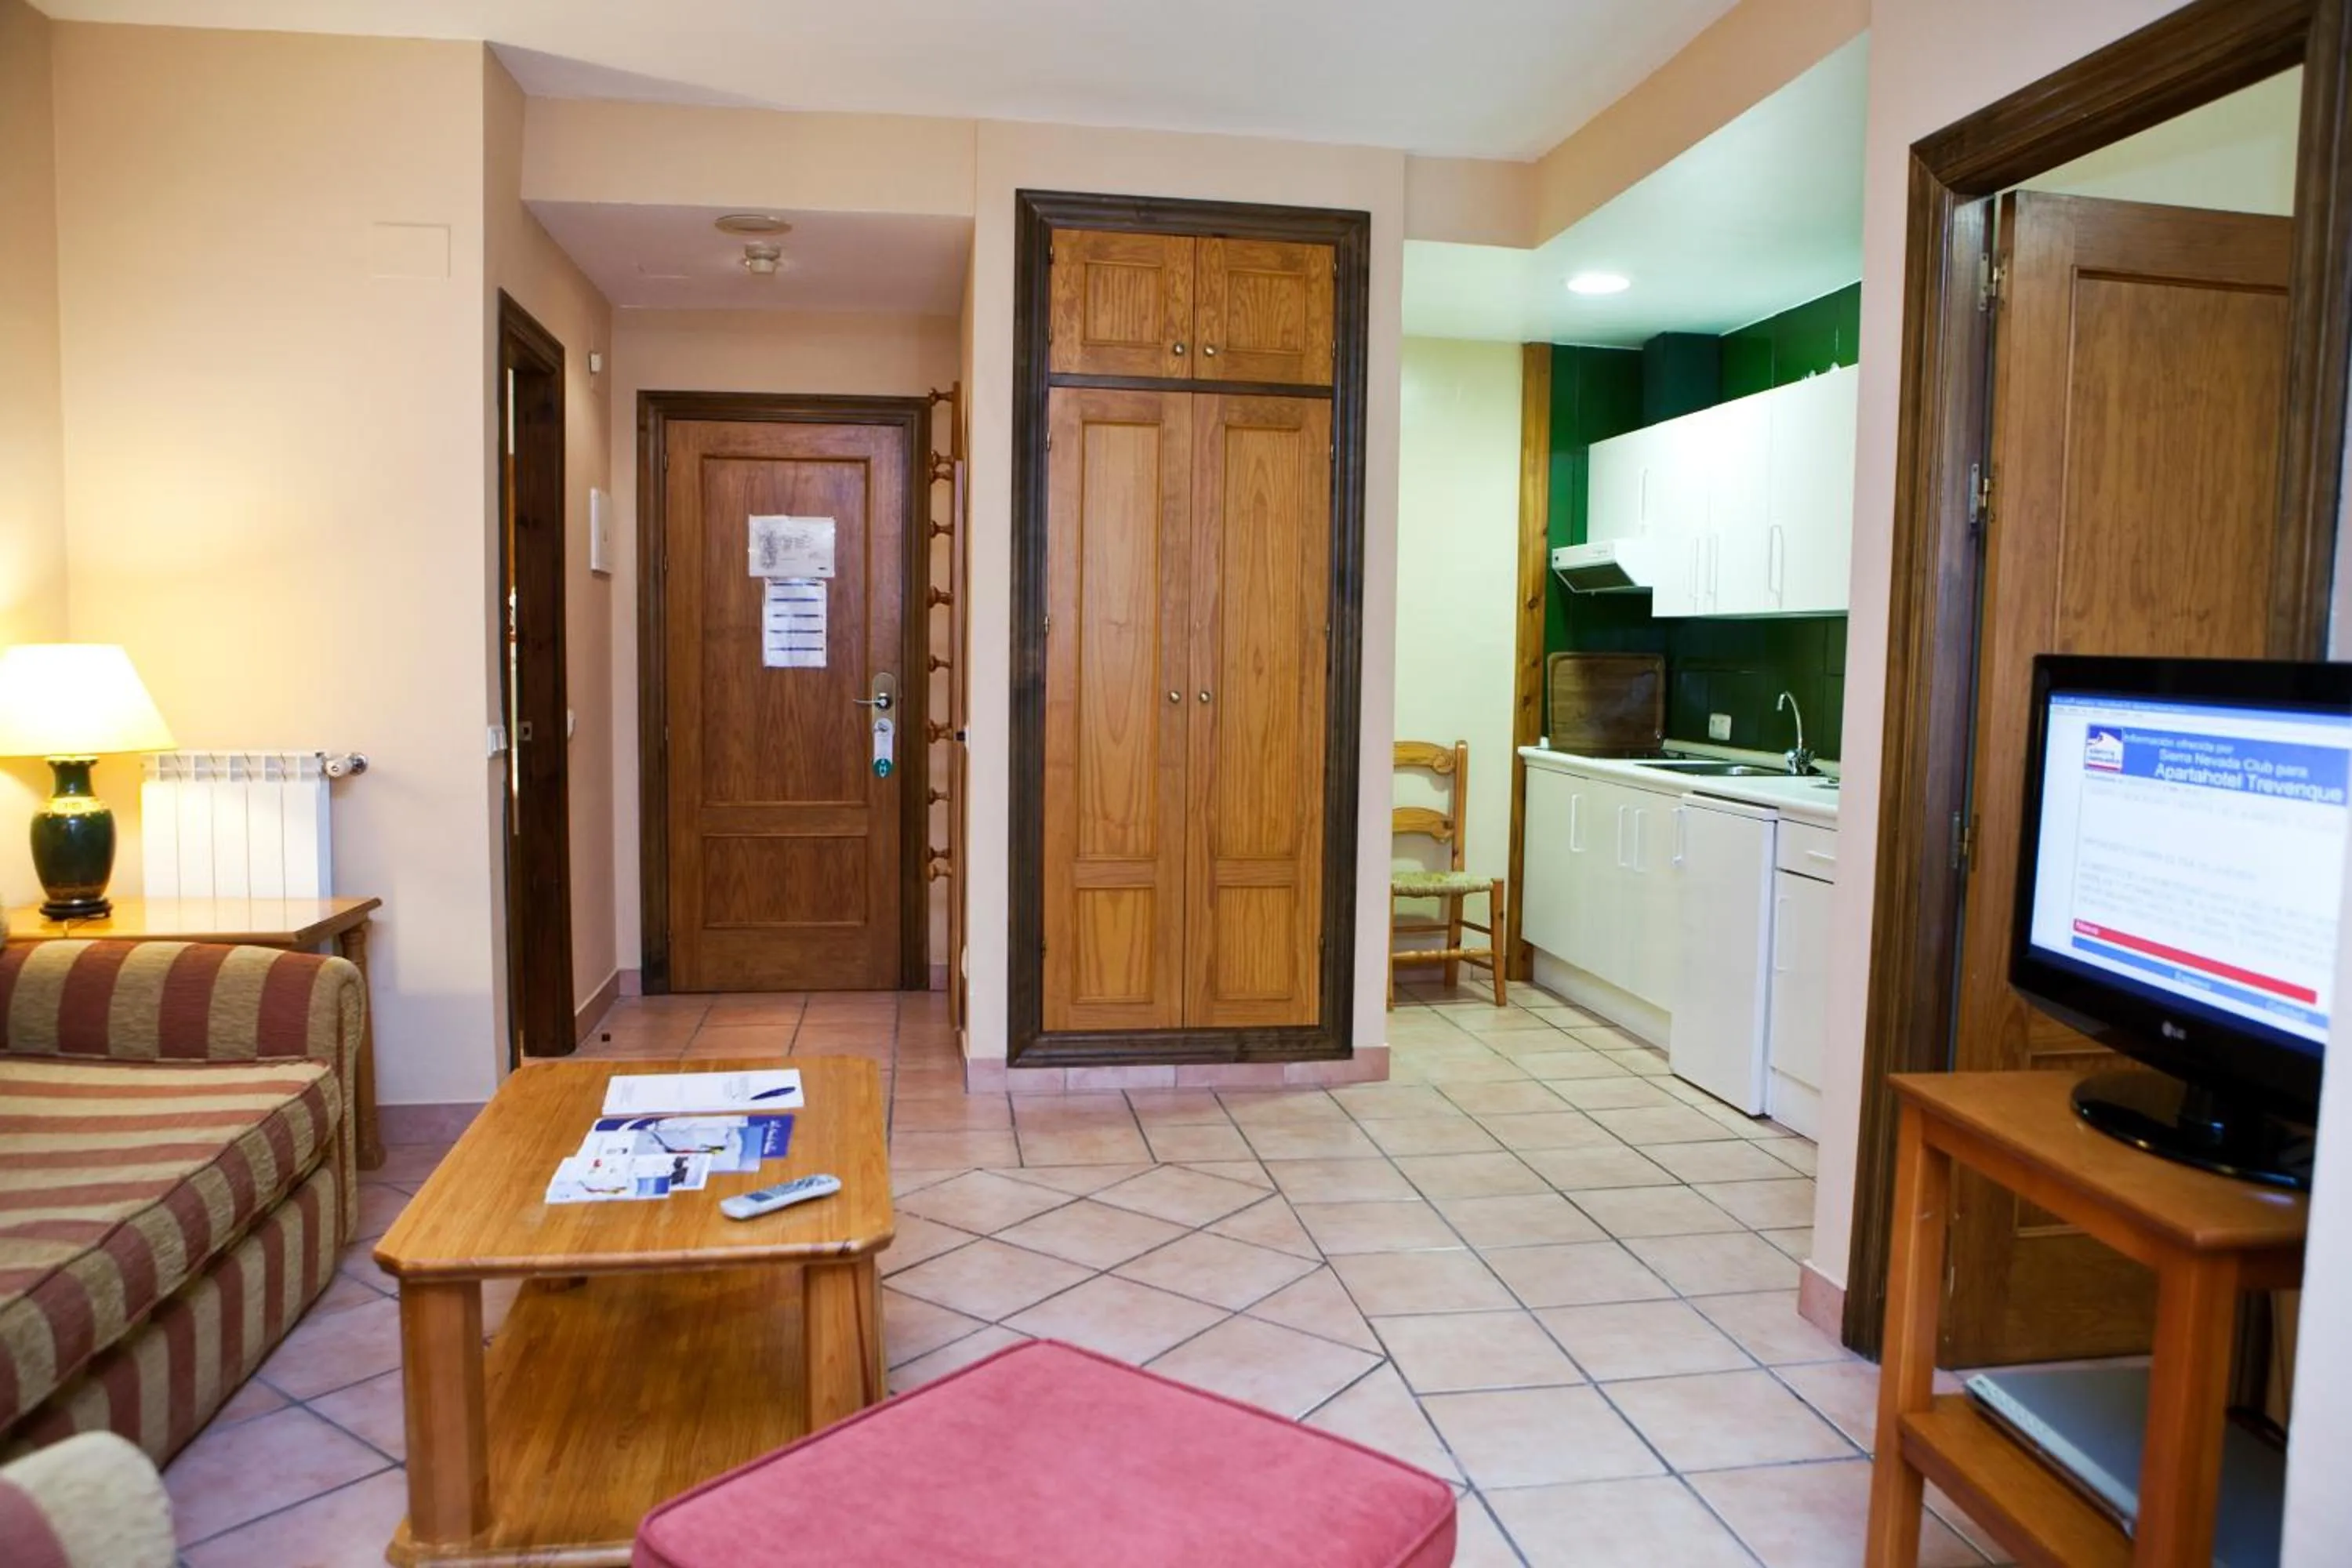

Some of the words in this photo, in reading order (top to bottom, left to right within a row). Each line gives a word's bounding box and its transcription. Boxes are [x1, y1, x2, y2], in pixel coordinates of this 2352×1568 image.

[2159, 748, 2192, 764] Sierra
[2194, 753, 2241, 770] Nevada
[2242, 757, 2273, 775] Club
[2275, 763, 2308, 779] para
[2154, 762, 2242, 790] Apartahotel
[2246, 773, 2343, 803] Trevenque
